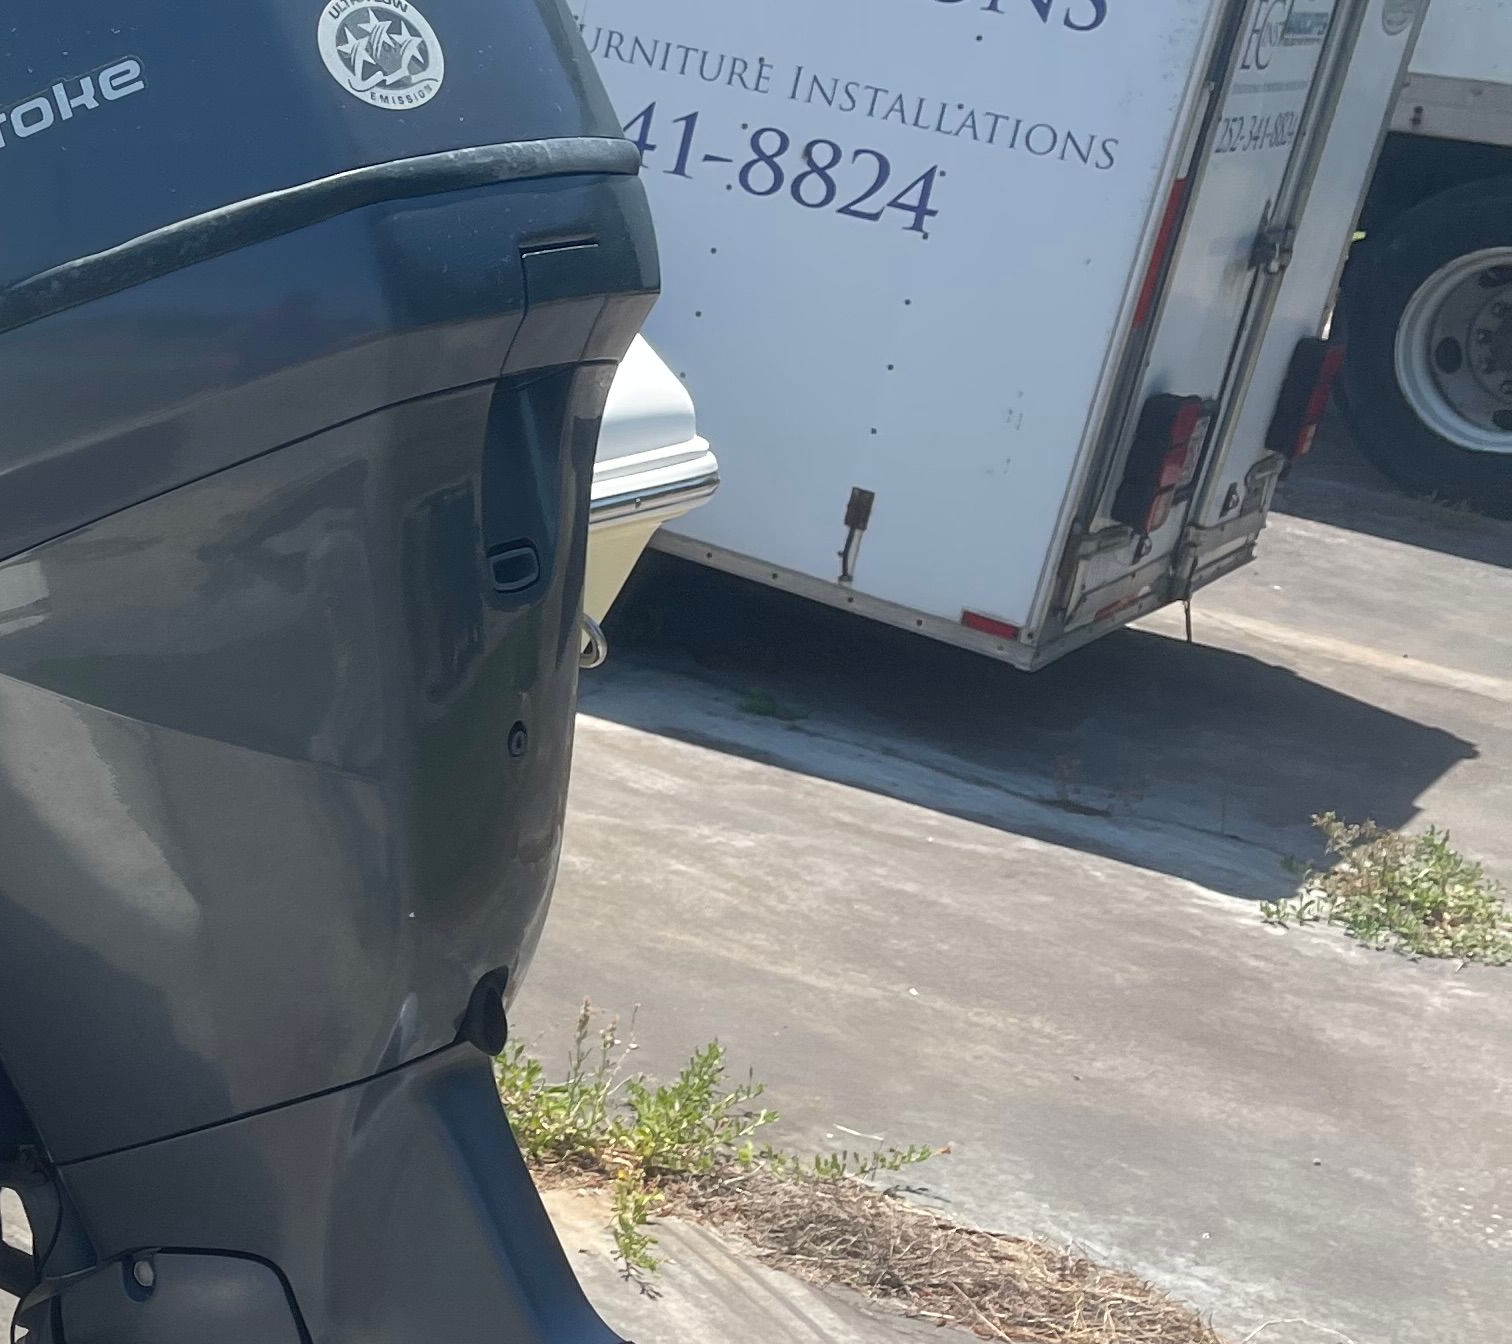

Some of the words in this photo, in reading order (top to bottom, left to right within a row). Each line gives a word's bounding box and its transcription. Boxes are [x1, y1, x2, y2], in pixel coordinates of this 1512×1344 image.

[369, 83, 433, 105] EMISSION
[580, 24, 773, 94] URNITURE
[788, 65, 1119, 170] INSTALLATIONS
[622, 101, 941, 234] 41-8824
